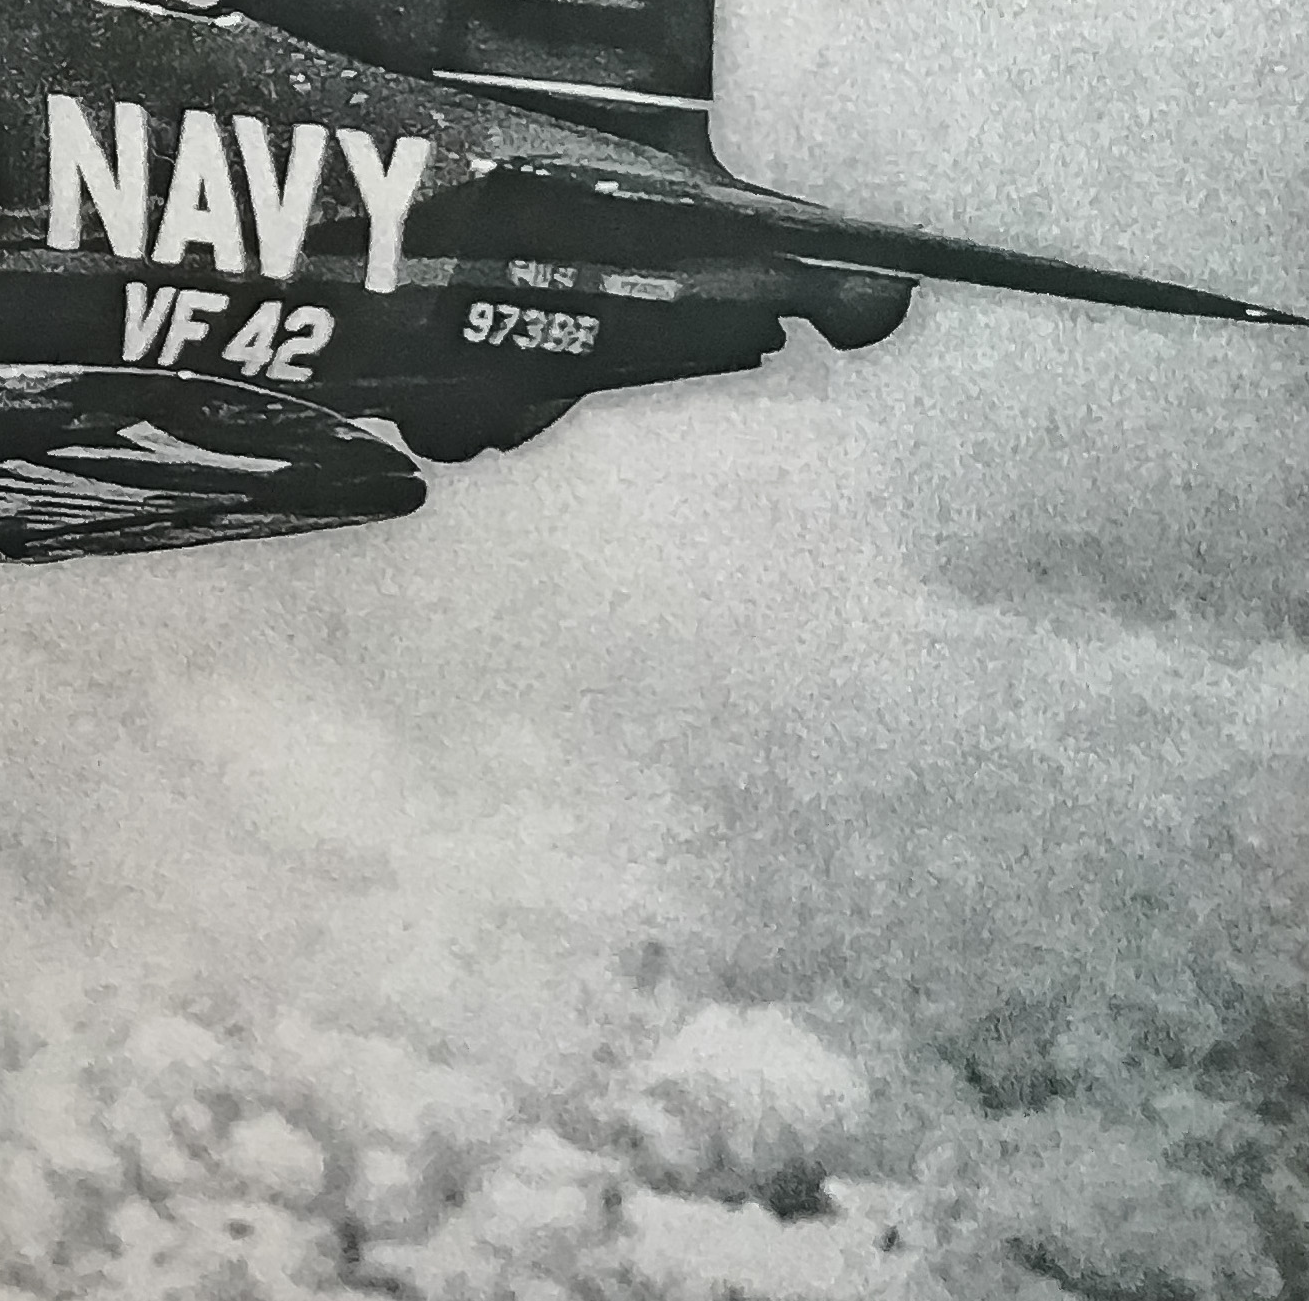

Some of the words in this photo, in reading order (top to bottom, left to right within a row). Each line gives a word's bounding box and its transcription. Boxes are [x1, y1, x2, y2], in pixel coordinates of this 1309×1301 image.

[46, 93, 432, 294] NAVY
[121, 281, 231, 367] VF
[221, 300, 337, 383] 42
